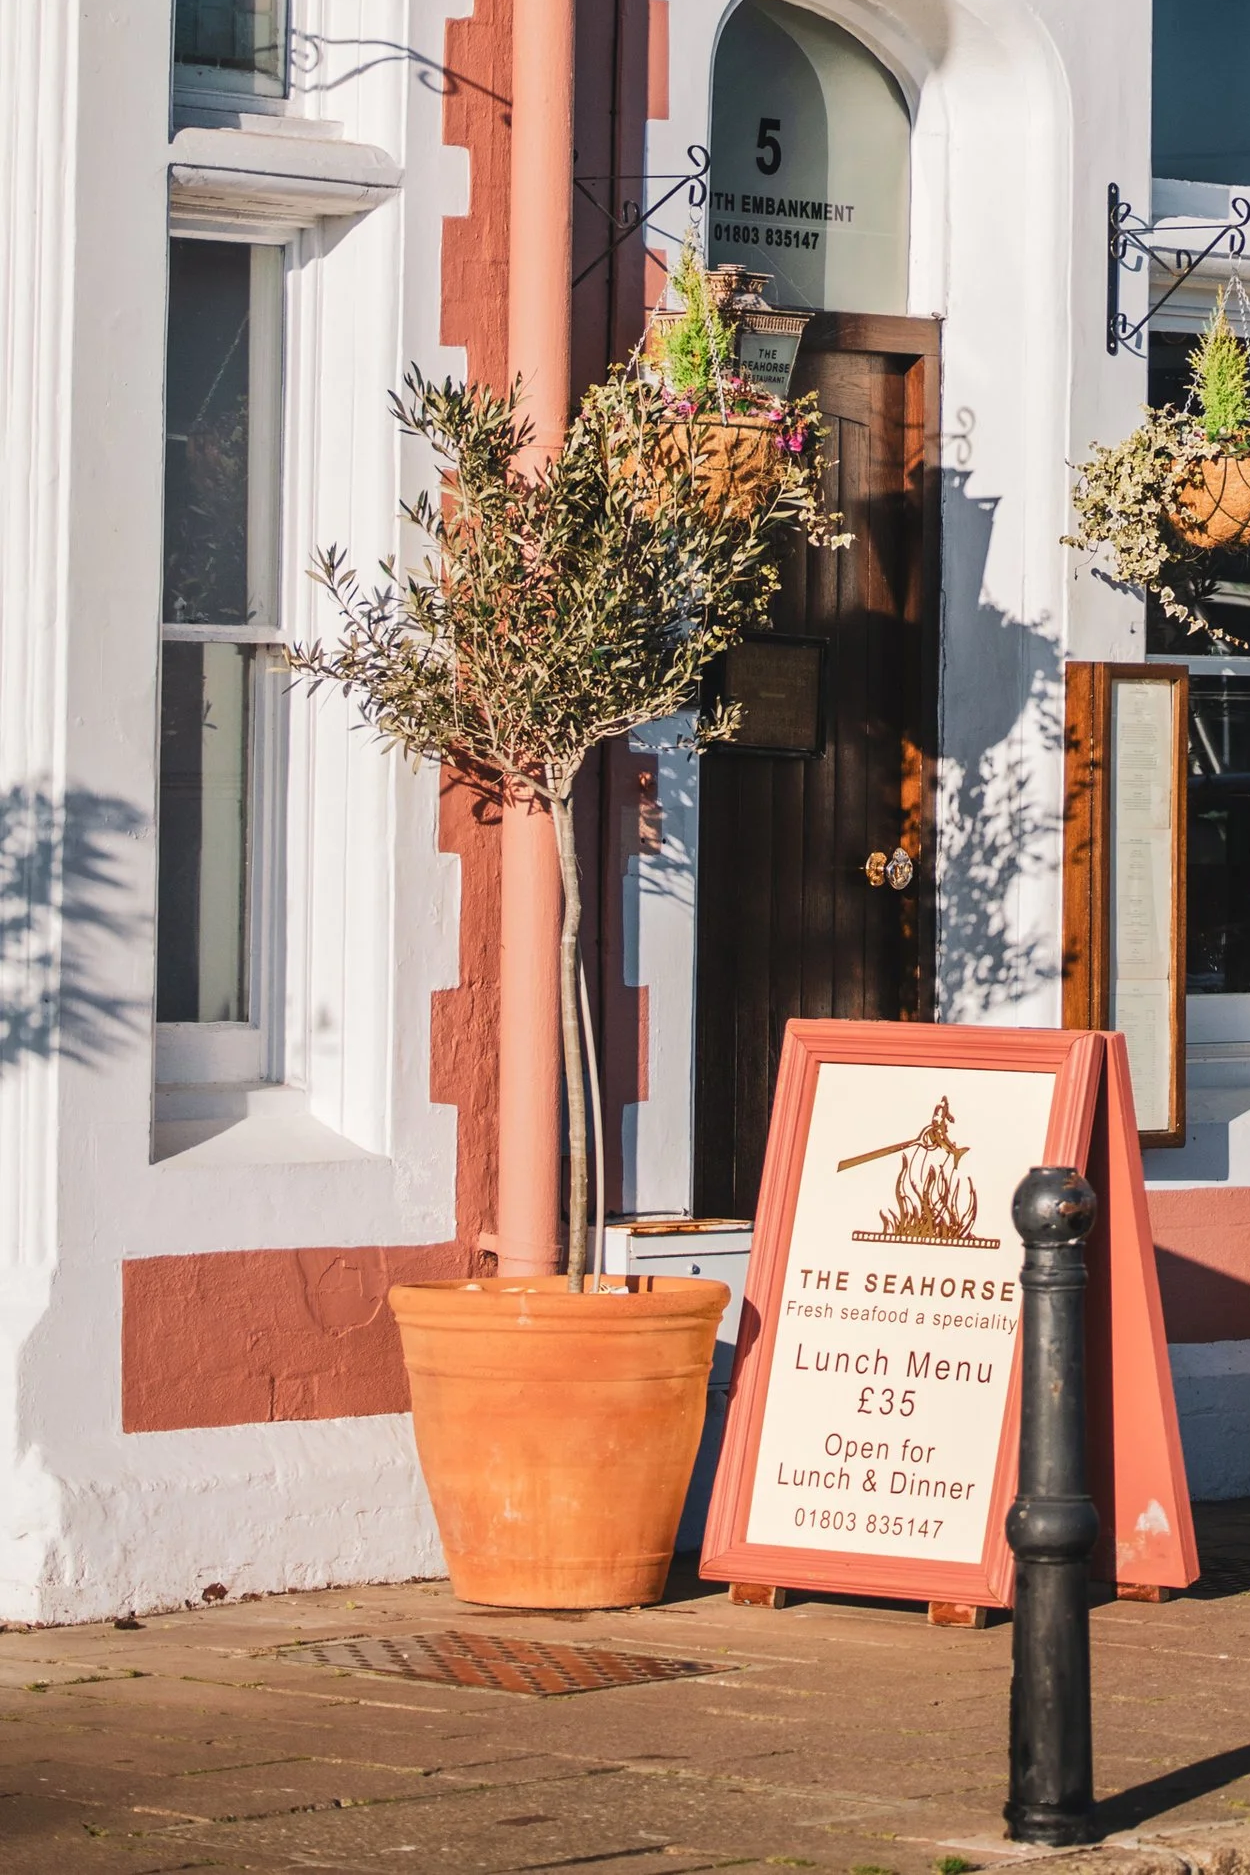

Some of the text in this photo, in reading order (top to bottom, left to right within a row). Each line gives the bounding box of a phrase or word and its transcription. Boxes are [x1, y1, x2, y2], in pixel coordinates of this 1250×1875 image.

[755, 117, 782, 176] 5
[741, 194, 854, 223] EMBANKMENT
[714, 223, 820, 250] 01803 835147
[742, 360, 791, 374] SEAHORSE
[758, 348, 778, 360] THE
[800, 1269, 1016, 1303] THE SEAHORSE
[786, 1300, 1019, 1335] Fresh seafood a speciality
[795, 1342, 993, 1385] Lunch Menu
[856, 1386, 916, 1418] £35
[824, 1432, 936, 1465] Open for
[777, 1462, 976, 1502] Lunch & Dinner
[794, 1507, 945, 1540] 01803 835147
